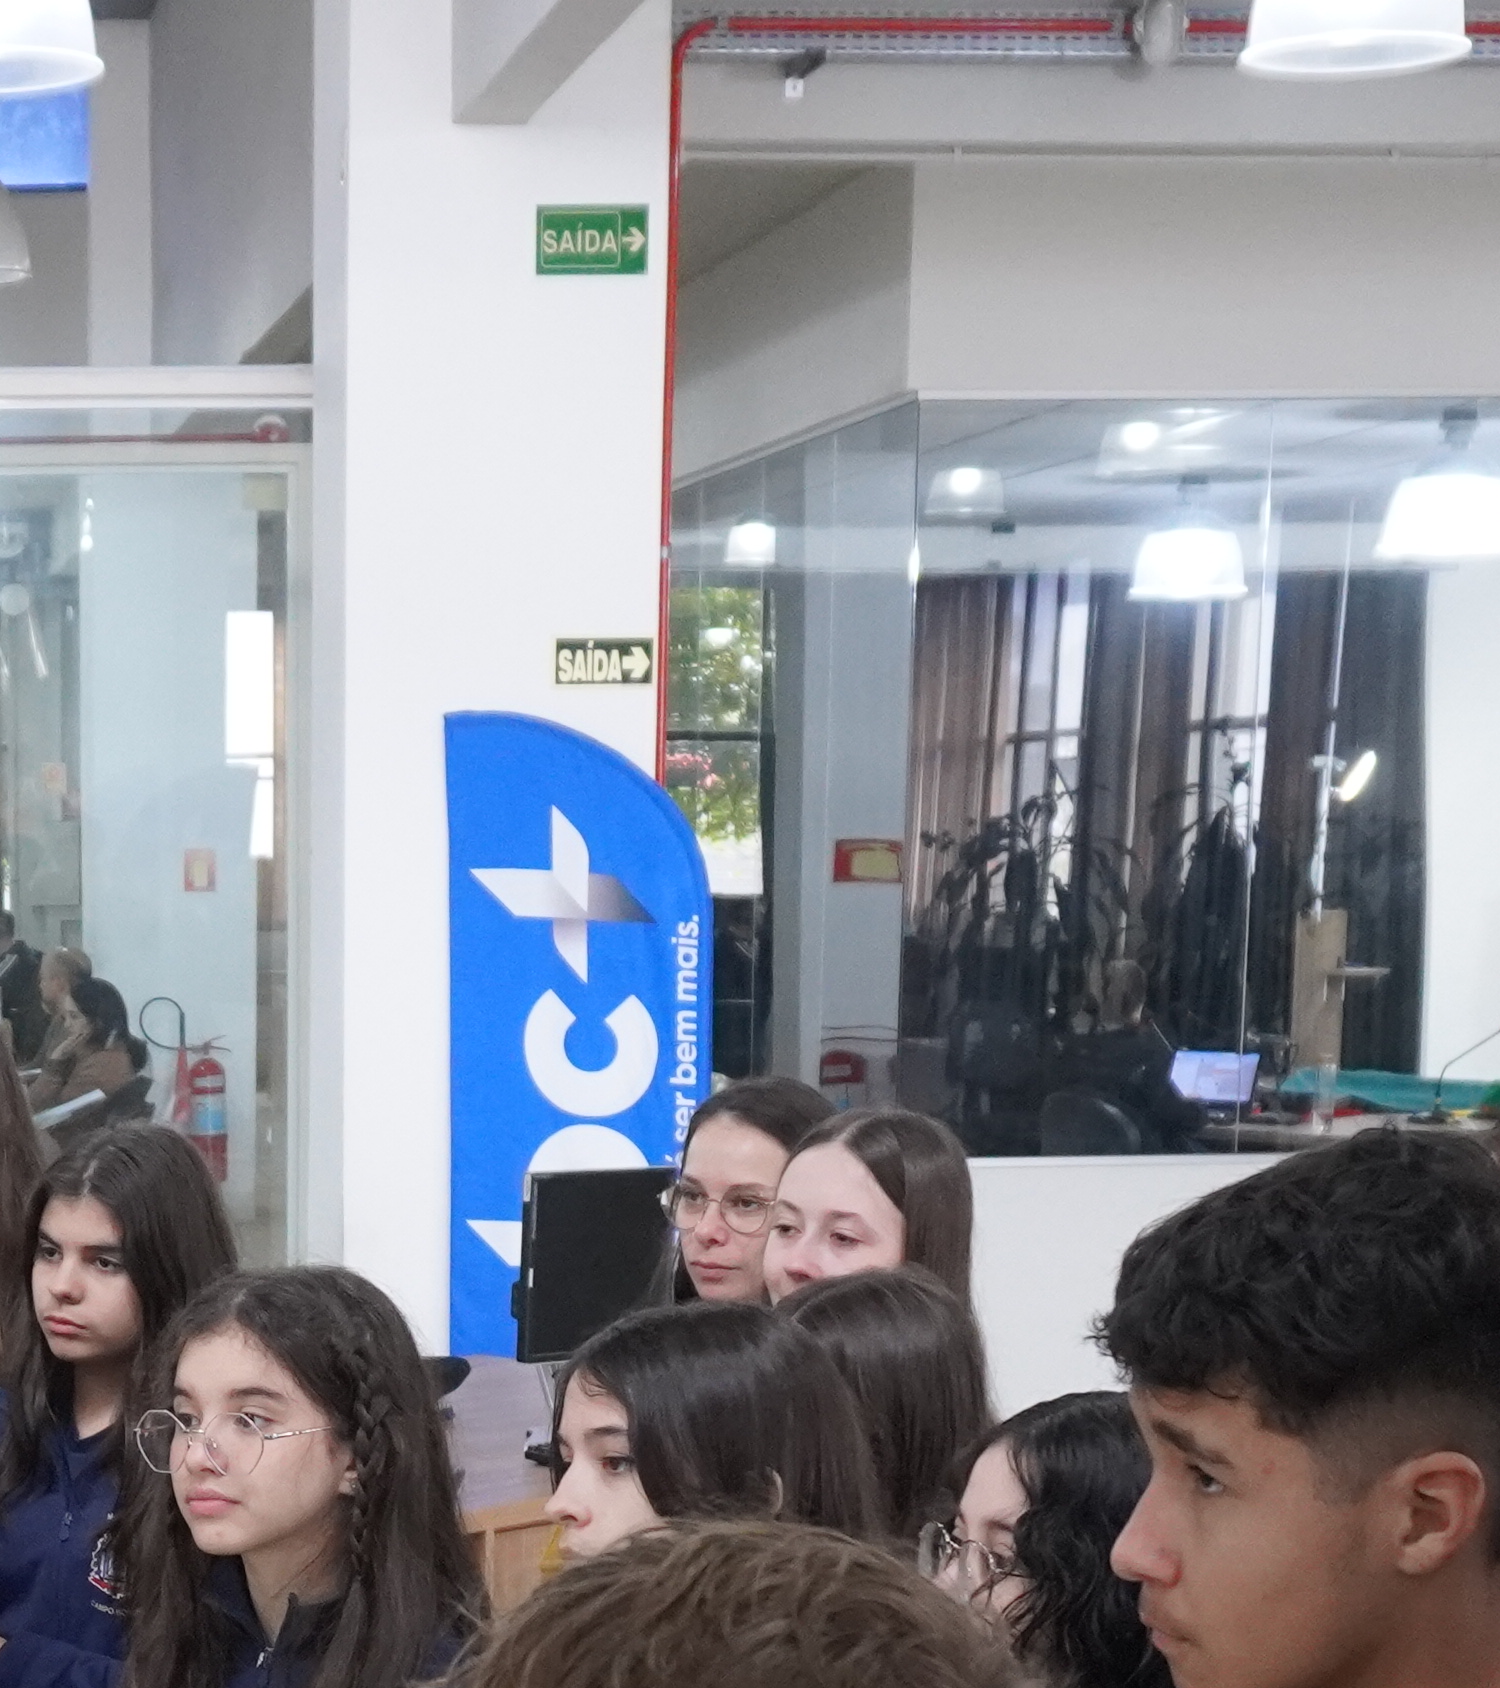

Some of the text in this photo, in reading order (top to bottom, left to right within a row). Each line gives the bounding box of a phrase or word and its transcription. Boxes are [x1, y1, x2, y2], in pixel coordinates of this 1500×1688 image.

[542, 221, 617, 254] SAÍDA
[558, 640, 622, 682] SAÍDA
[671, 915, 700, 1002] mais.
[669, 1008, 698, 1087] bem
